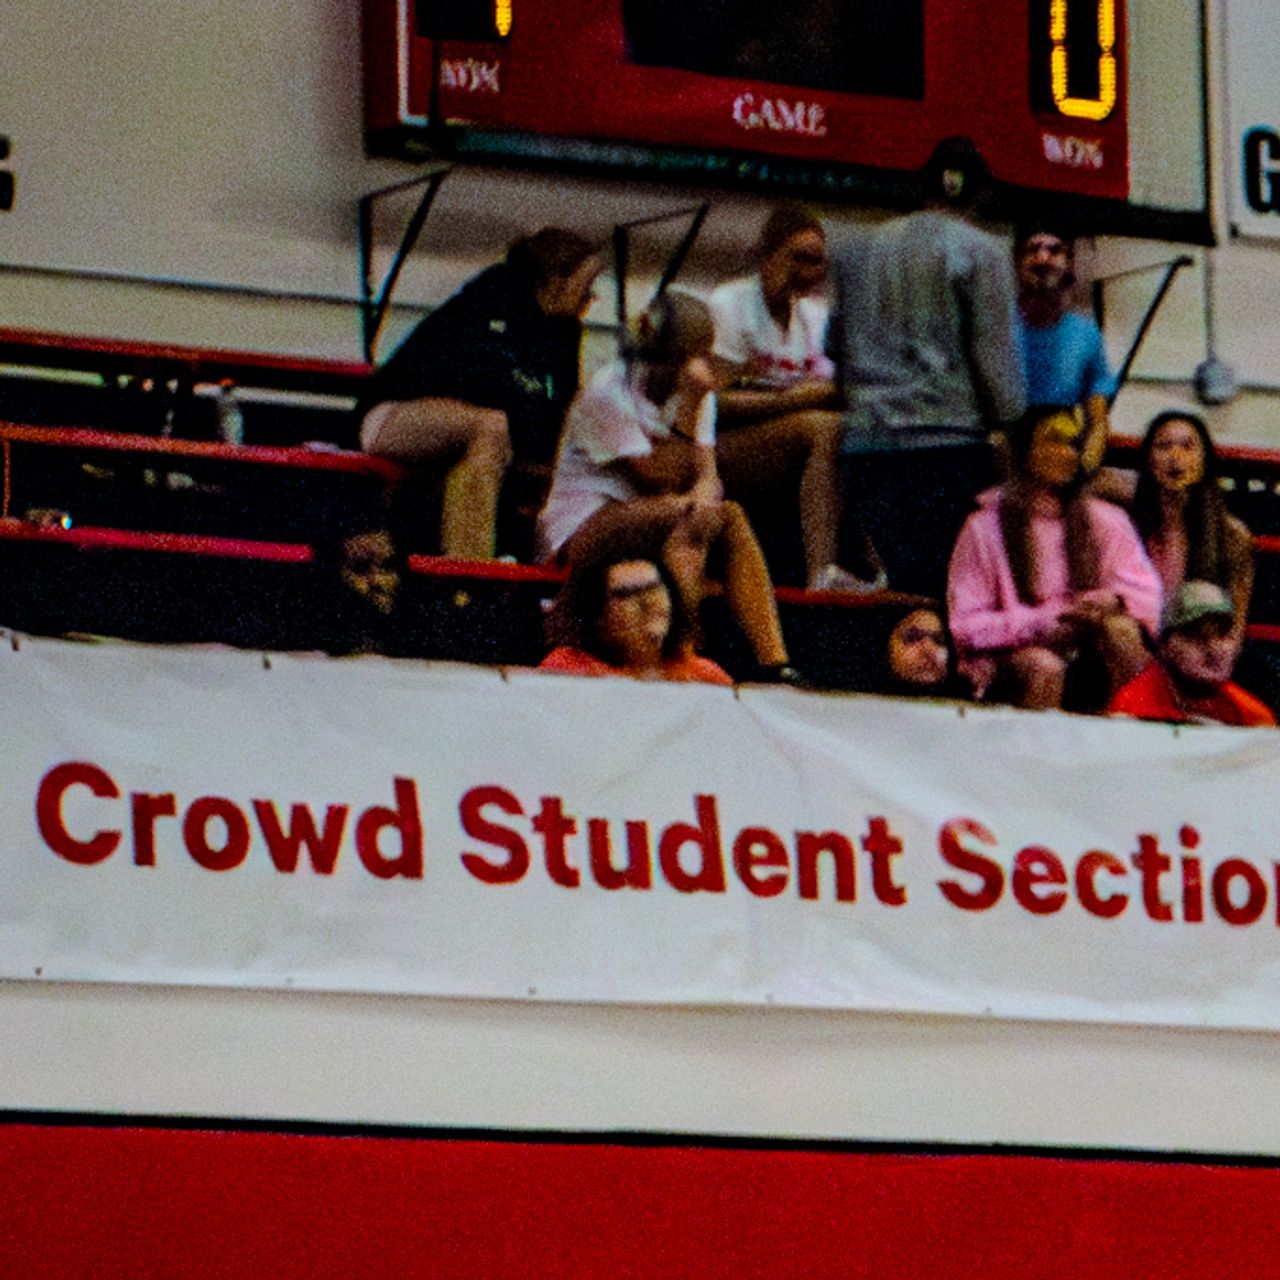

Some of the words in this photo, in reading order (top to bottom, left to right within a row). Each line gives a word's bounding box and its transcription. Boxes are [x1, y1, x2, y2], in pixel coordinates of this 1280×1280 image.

[732, 92, 828, 137] GAME
[36, 760, 424, 880] Crowd
[459, 784, 908, 906] Student
